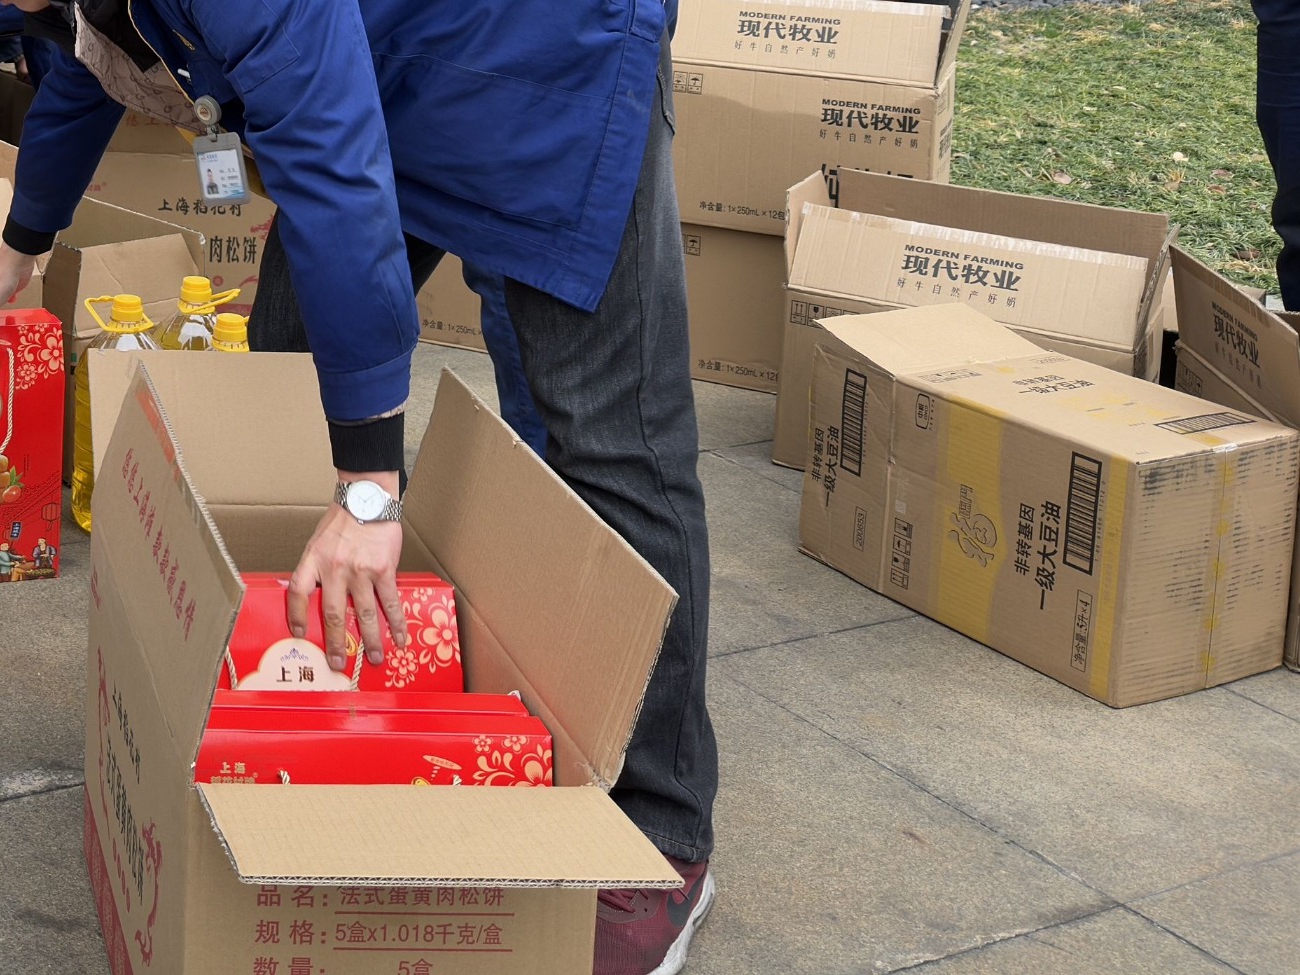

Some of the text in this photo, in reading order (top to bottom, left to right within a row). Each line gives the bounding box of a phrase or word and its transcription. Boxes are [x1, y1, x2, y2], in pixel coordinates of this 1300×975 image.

[739, 10, 841, 26] MODERN FARMING
[737, 19, 840, 45] 现代牧业
[734, 40, 837, 60] 好牛自然产好奶
[822, 98, 921, 115] MODERN FARMING
[820, 108, 920, 135] 现代牧业
[819, 128, 919, 150] 好牛自然产好奶
[209, 235, 257, 265] 肉松饼
[904, 244, 1024, 270] MODERN FARMING
[901, 254, 1021, 292] 现代牧业
[897, 277, 1016, 308] 好牛自然产好奶
[1213, 313, 1260, 369] 现代牧业
[811, 427, 825, 482] 非转基因
[823, 425, 840, 508] 一级大豆油
[1014, 502, 1035, 576] 非转基因
[1035, 500, 1062, 611] 一级大豆油
[276, 665, 315, 683] 上海
[220, 761, 246, 774] 上海
[339, 886, 505, 907] 法式蛋黄肉松饼
